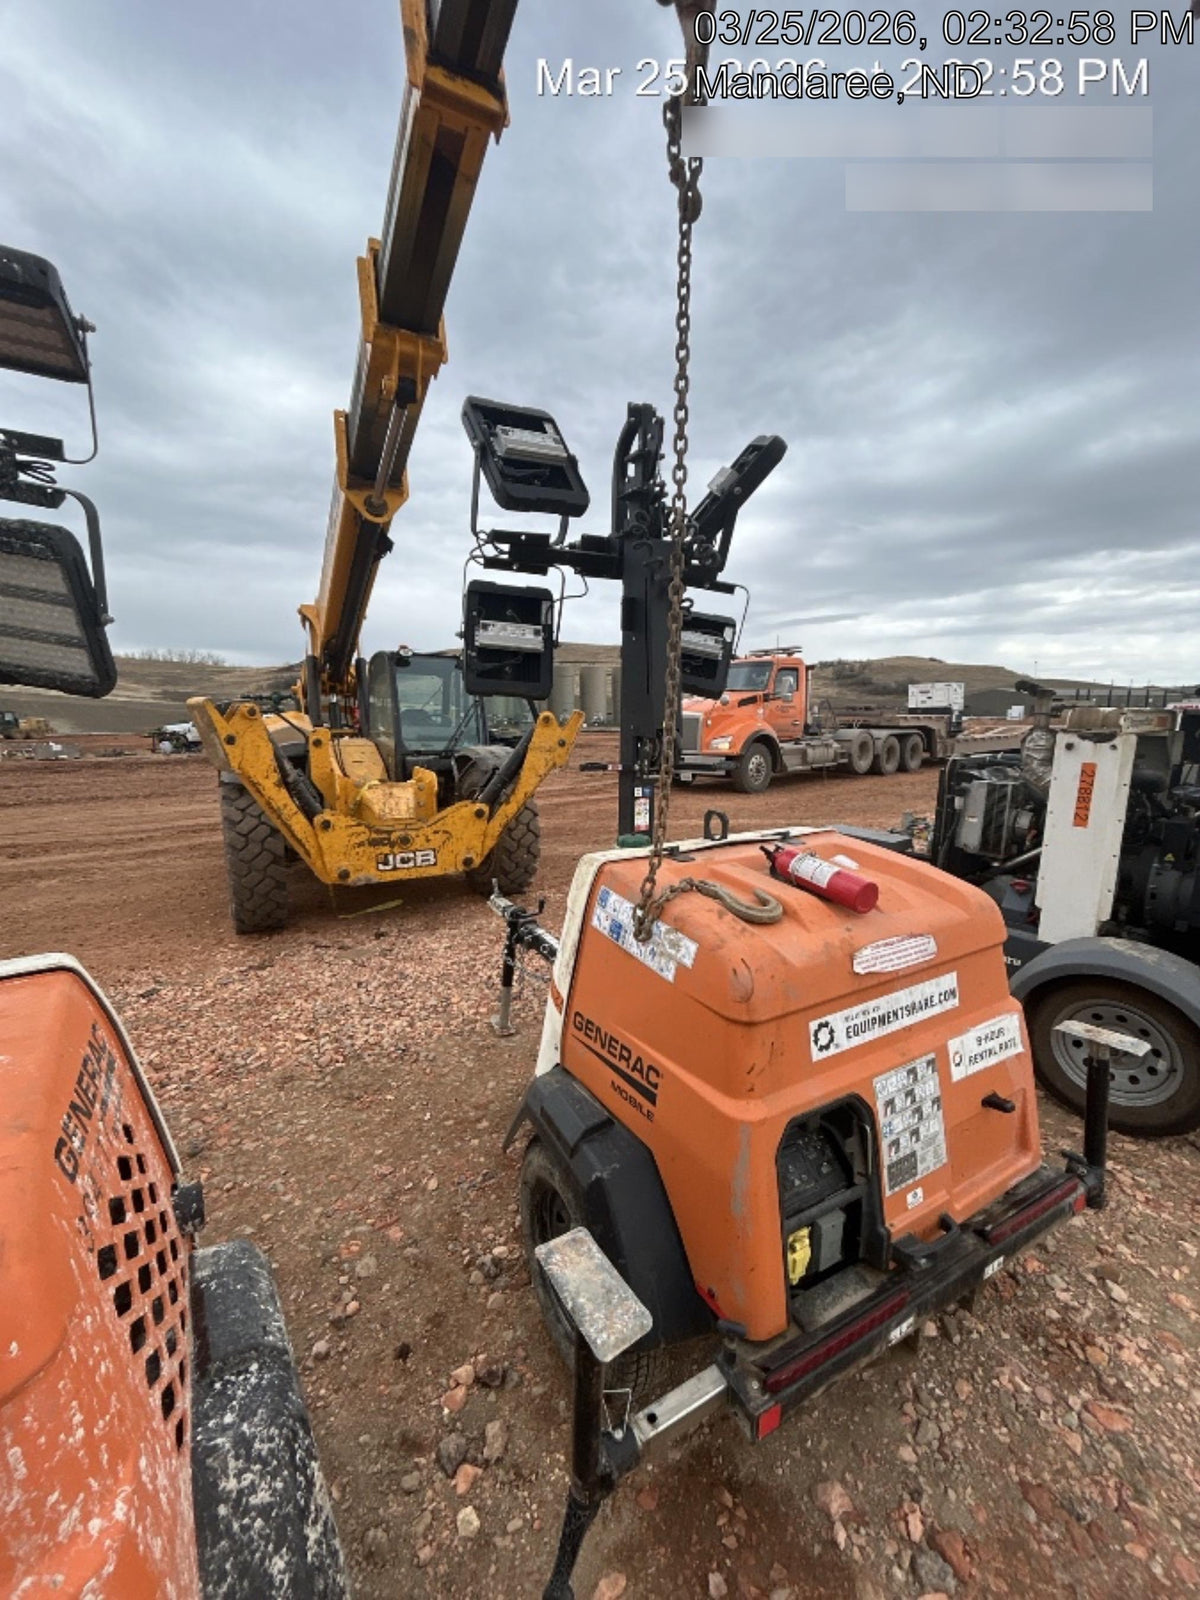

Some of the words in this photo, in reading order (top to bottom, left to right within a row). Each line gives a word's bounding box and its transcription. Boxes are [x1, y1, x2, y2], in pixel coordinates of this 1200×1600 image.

[1074, 769, 1095, 821] 278812
[376, 848, 437, 871] JCB
[573, 1010, 660, 1091] GENERAC
[610, 1080, 655, 1122] MOBILE
